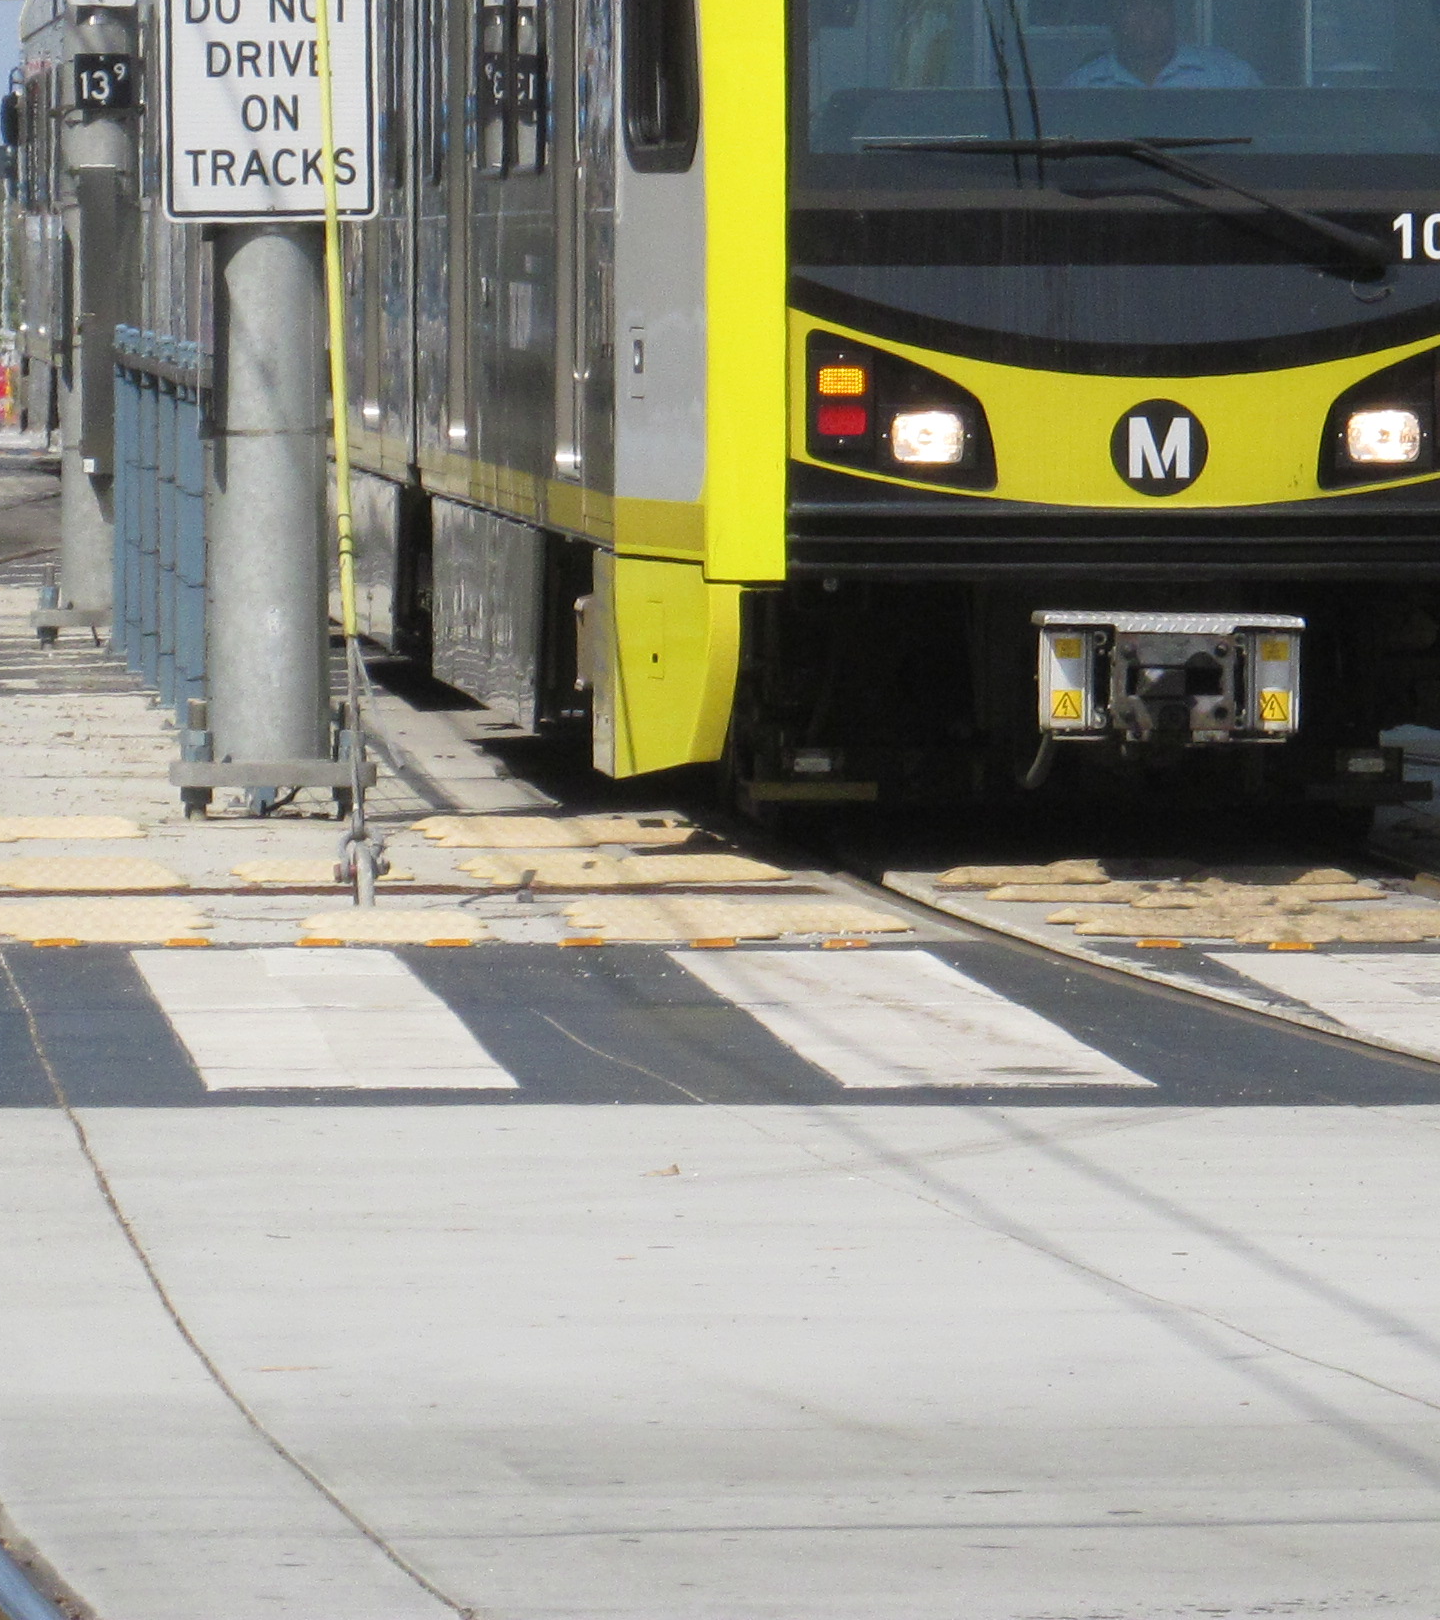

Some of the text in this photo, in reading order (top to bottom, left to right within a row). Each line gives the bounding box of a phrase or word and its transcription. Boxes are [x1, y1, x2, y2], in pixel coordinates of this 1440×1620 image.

[241, 94, 299, 131] ON
[184, 147, 357, 186] TRACKS
[1128, 417, 1191, 479] M
